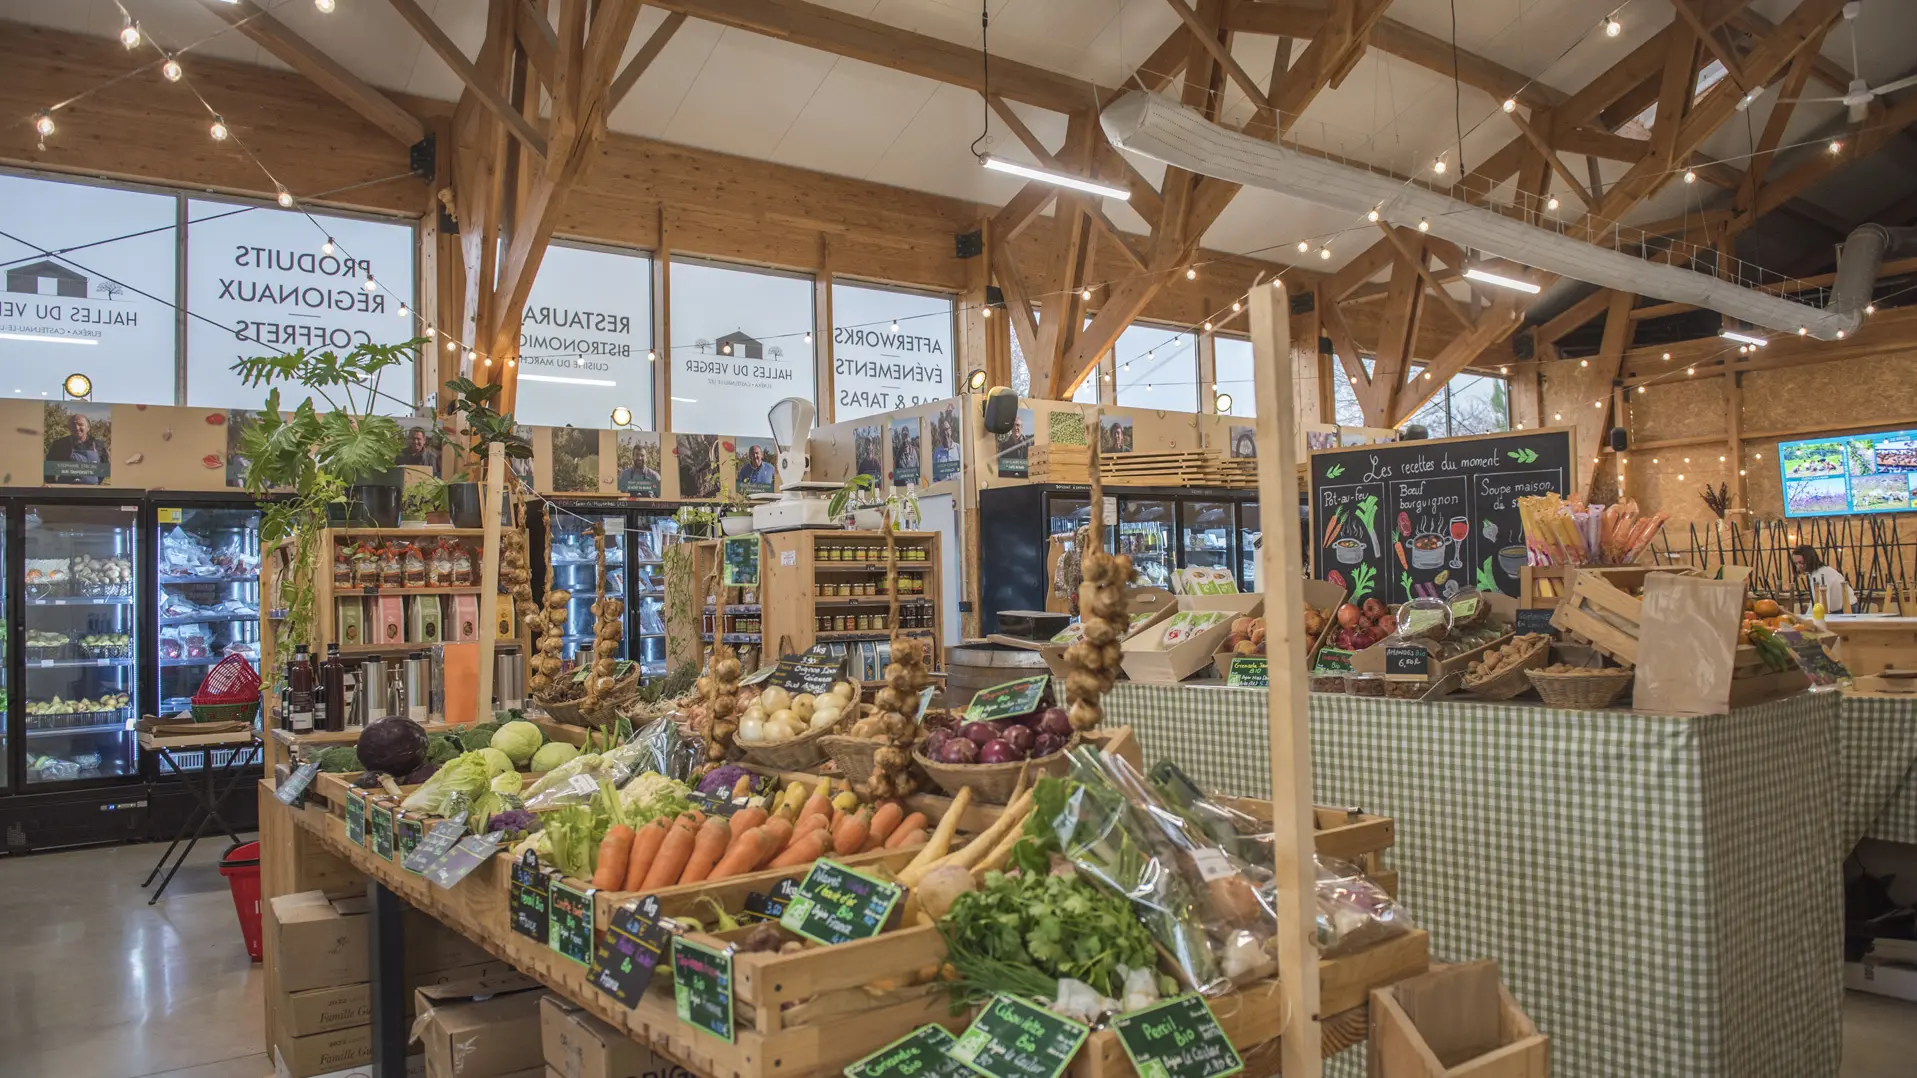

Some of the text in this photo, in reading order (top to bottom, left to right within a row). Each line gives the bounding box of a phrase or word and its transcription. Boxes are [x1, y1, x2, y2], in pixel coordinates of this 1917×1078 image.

[1363, 447, 1500, 483] Les recettes du moment
[1323, 486, 1369, 507] Pot-au-feu
[1481, 477, 1511, 500] Soupe
[1399, 495, 1459, 514] bourguignon
[812, 644, 826, 654] 1kg
[320, 1008, 355, 1023] Famille
[1141, 1015, 1177, 1040] Persil
[320, 1048, 355, 1064] Famille
